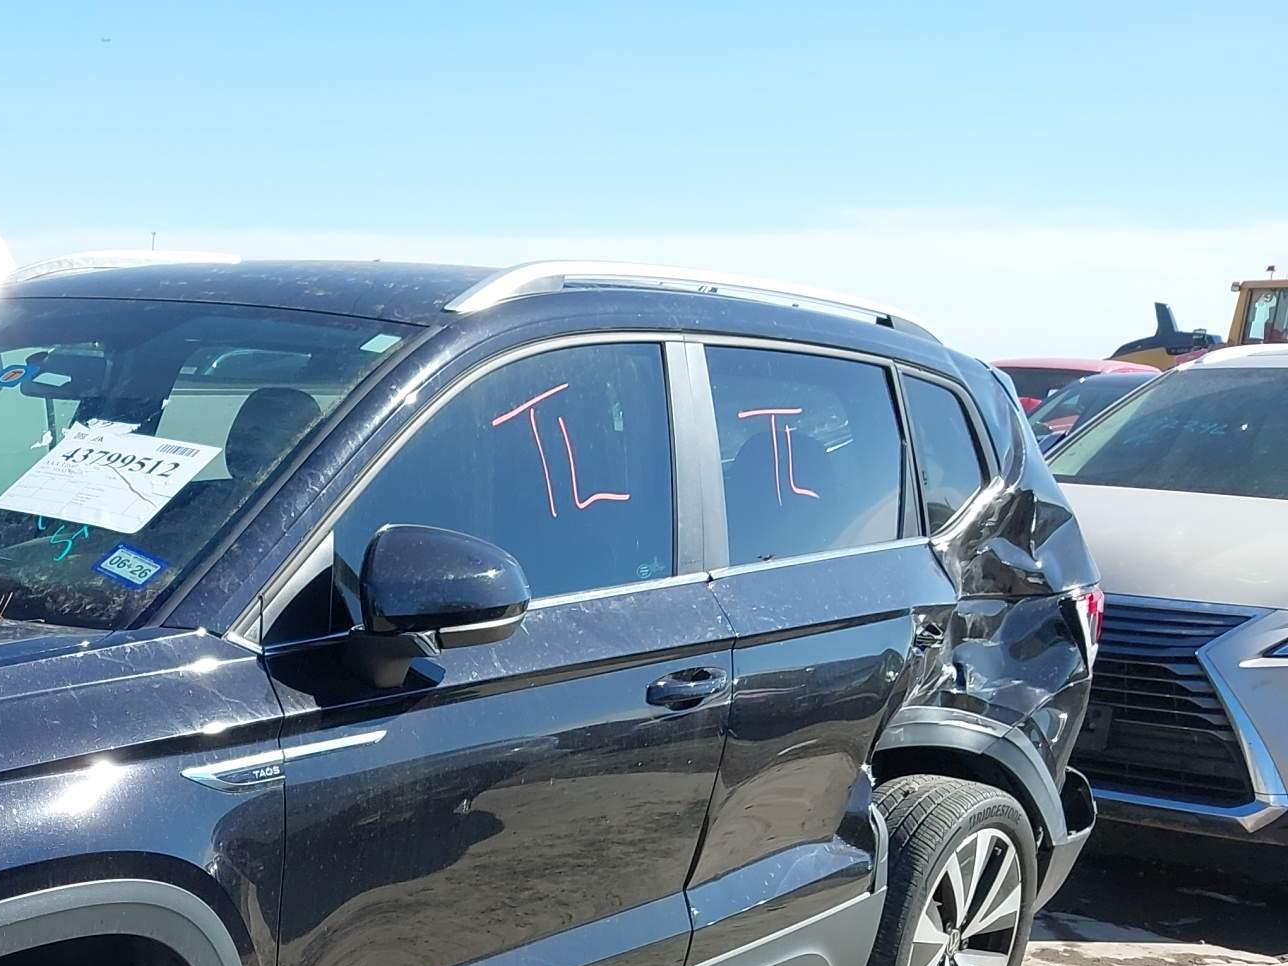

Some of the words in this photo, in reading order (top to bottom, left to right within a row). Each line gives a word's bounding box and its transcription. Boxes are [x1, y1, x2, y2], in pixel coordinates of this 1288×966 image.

[62, 447, 180, 477] 43799512
[492, 383, 631, 518] TL
[738, 408, 821, 506] TL
[252, 765, 281, 779] TAOS
